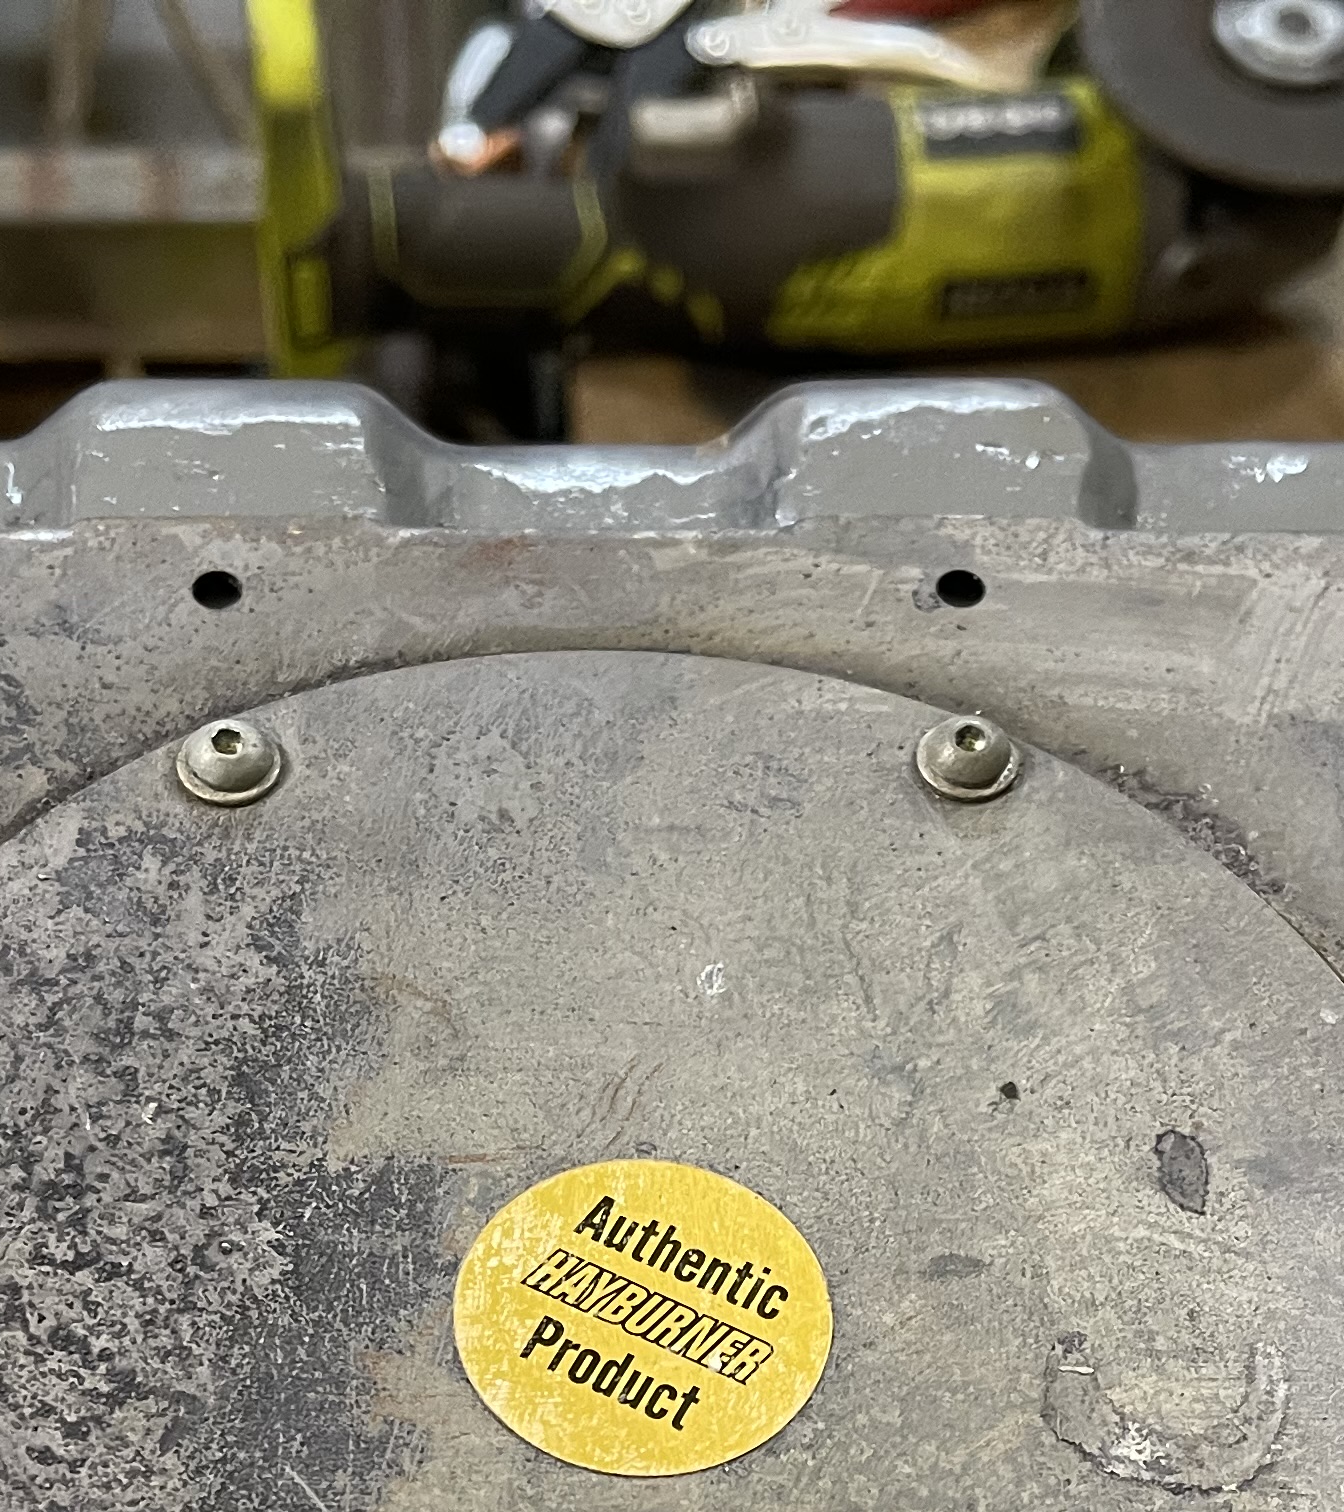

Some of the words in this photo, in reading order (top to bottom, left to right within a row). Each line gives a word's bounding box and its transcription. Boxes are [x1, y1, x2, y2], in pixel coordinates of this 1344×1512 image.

[520, 1249, 774, 1386] HAYBURNER
[574, 1196, 789, 1320] Authentic
[519, 1316, 700, 1431] Product
